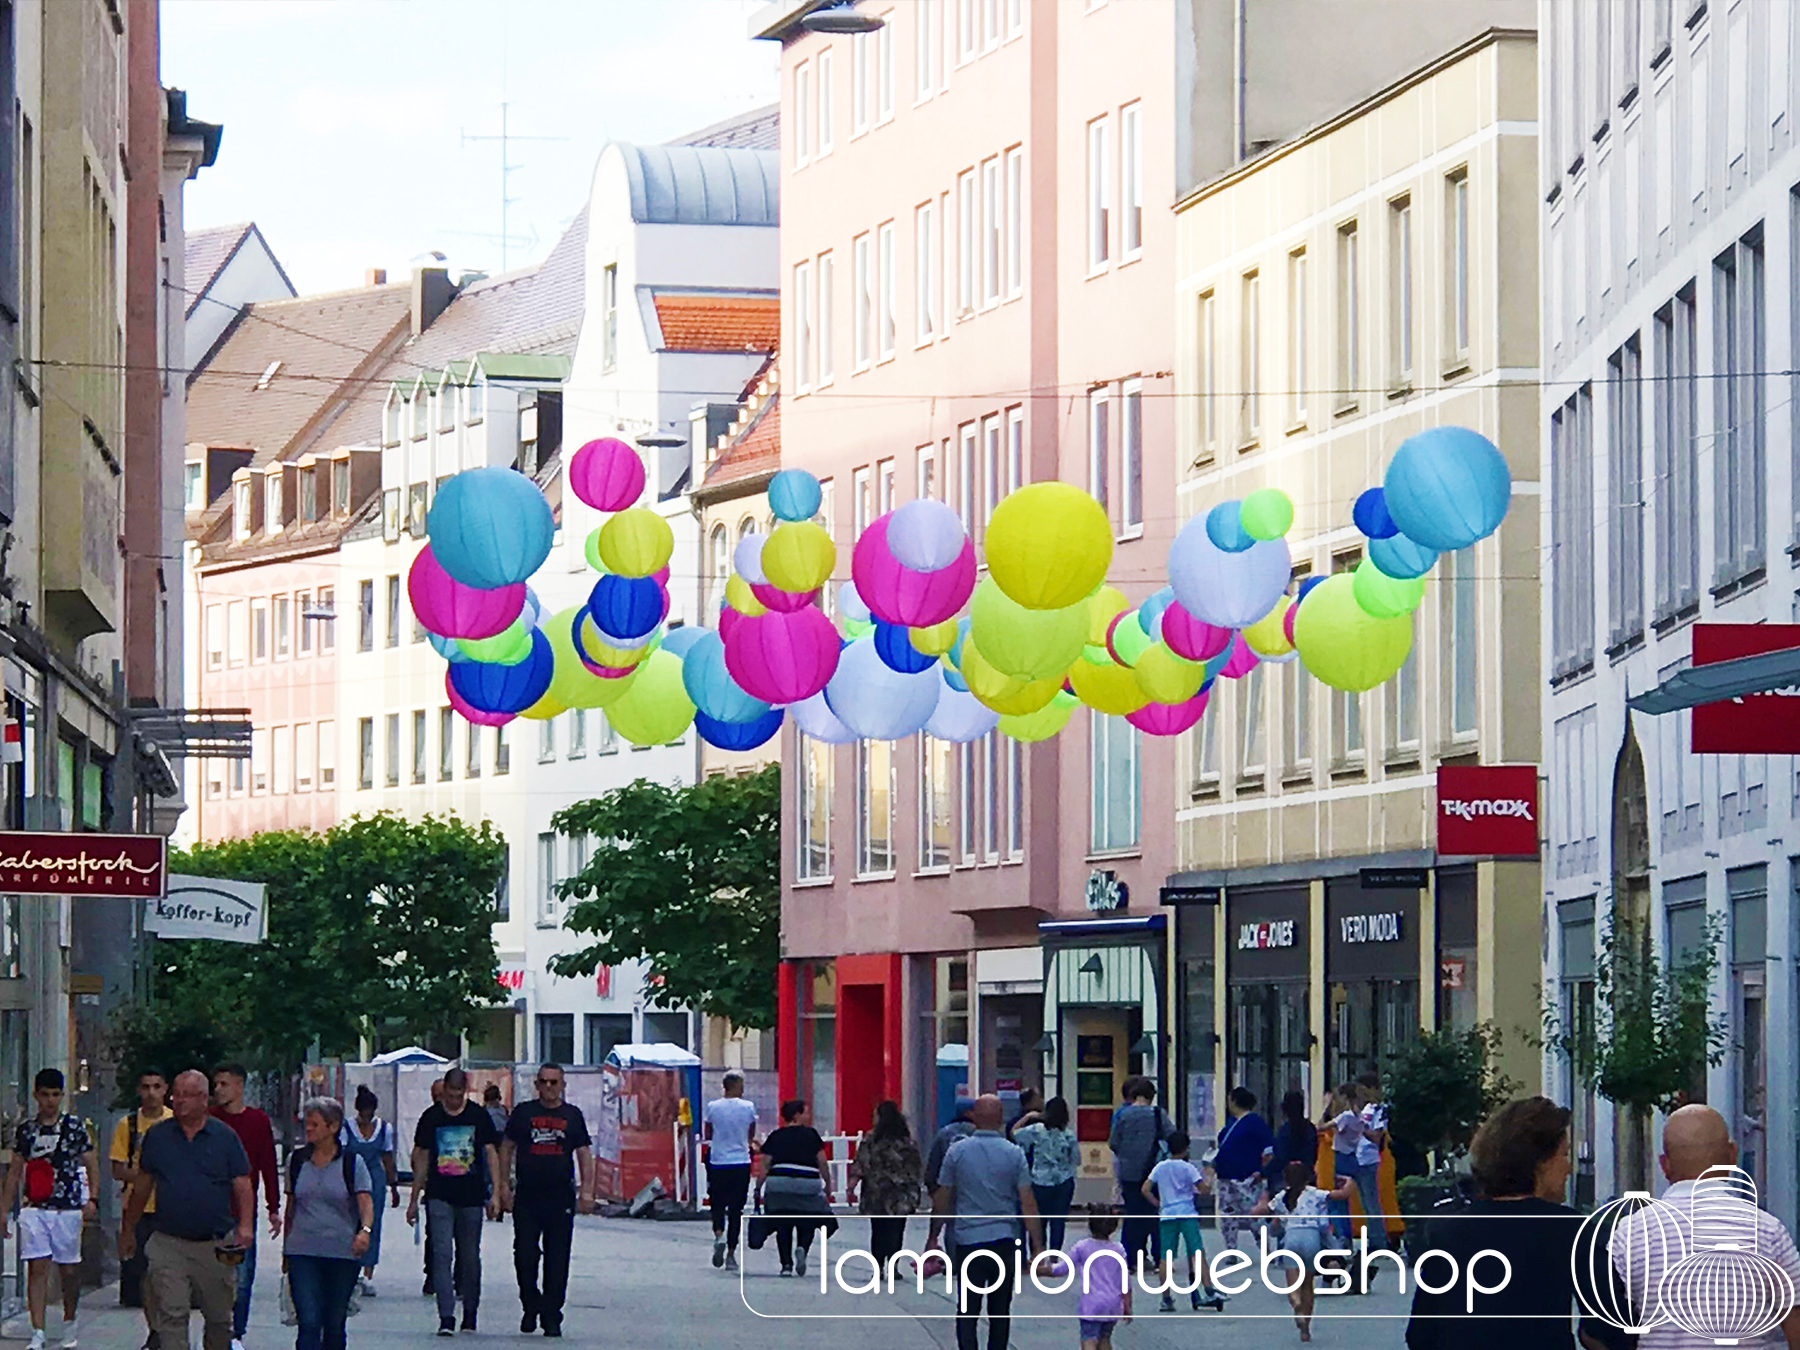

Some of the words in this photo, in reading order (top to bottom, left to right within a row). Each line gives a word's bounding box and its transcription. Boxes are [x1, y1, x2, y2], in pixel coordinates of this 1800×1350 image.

[0, 850, 159, 881] aberstock
[1341, 915, 1367, 943] VERO
[1368, 912, 1399, 942] MODA
